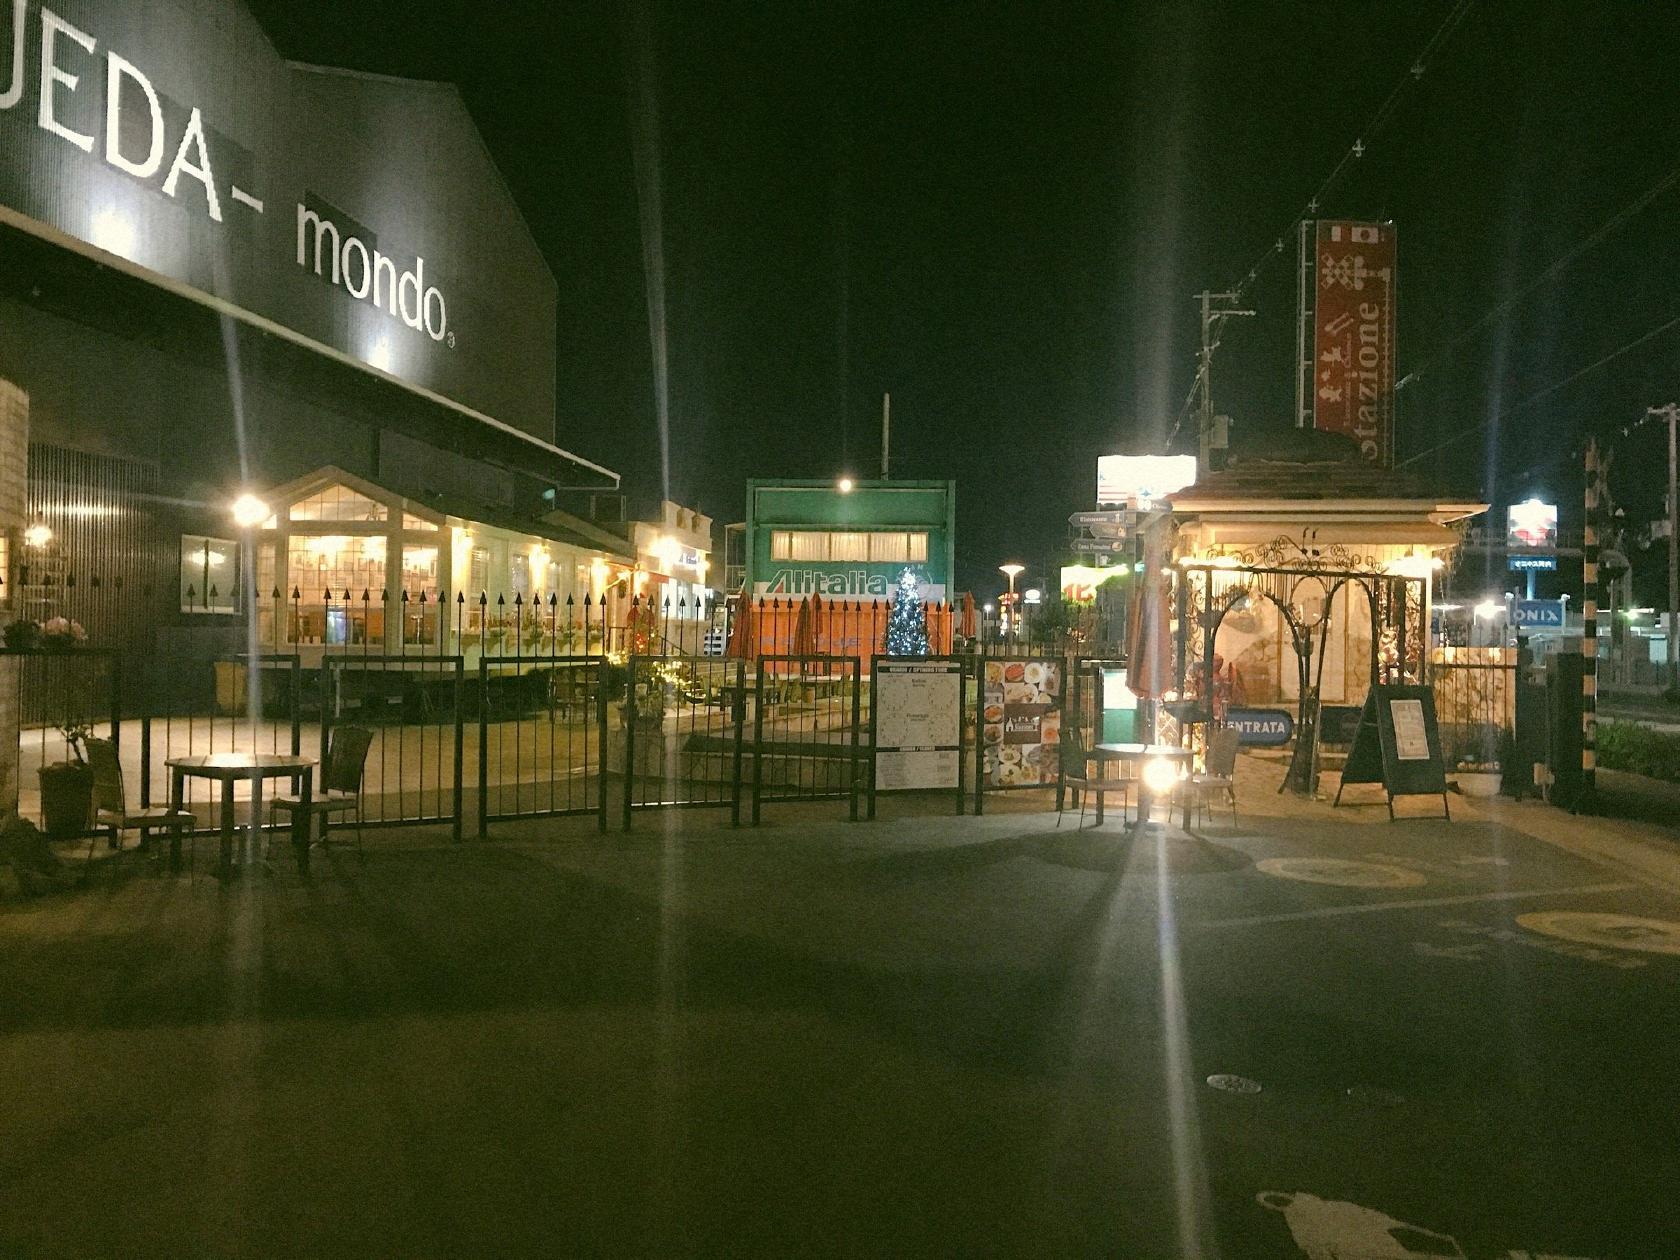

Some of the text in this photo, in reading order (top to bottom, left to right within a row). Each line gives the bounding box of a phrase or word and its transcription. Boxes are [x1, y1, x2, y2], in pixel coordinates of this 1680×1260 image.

[297, 203, 446, 341] mondo
[766, 570, 889, 595] Alitalia
[1513, 609, 1559, 621] ONIX
